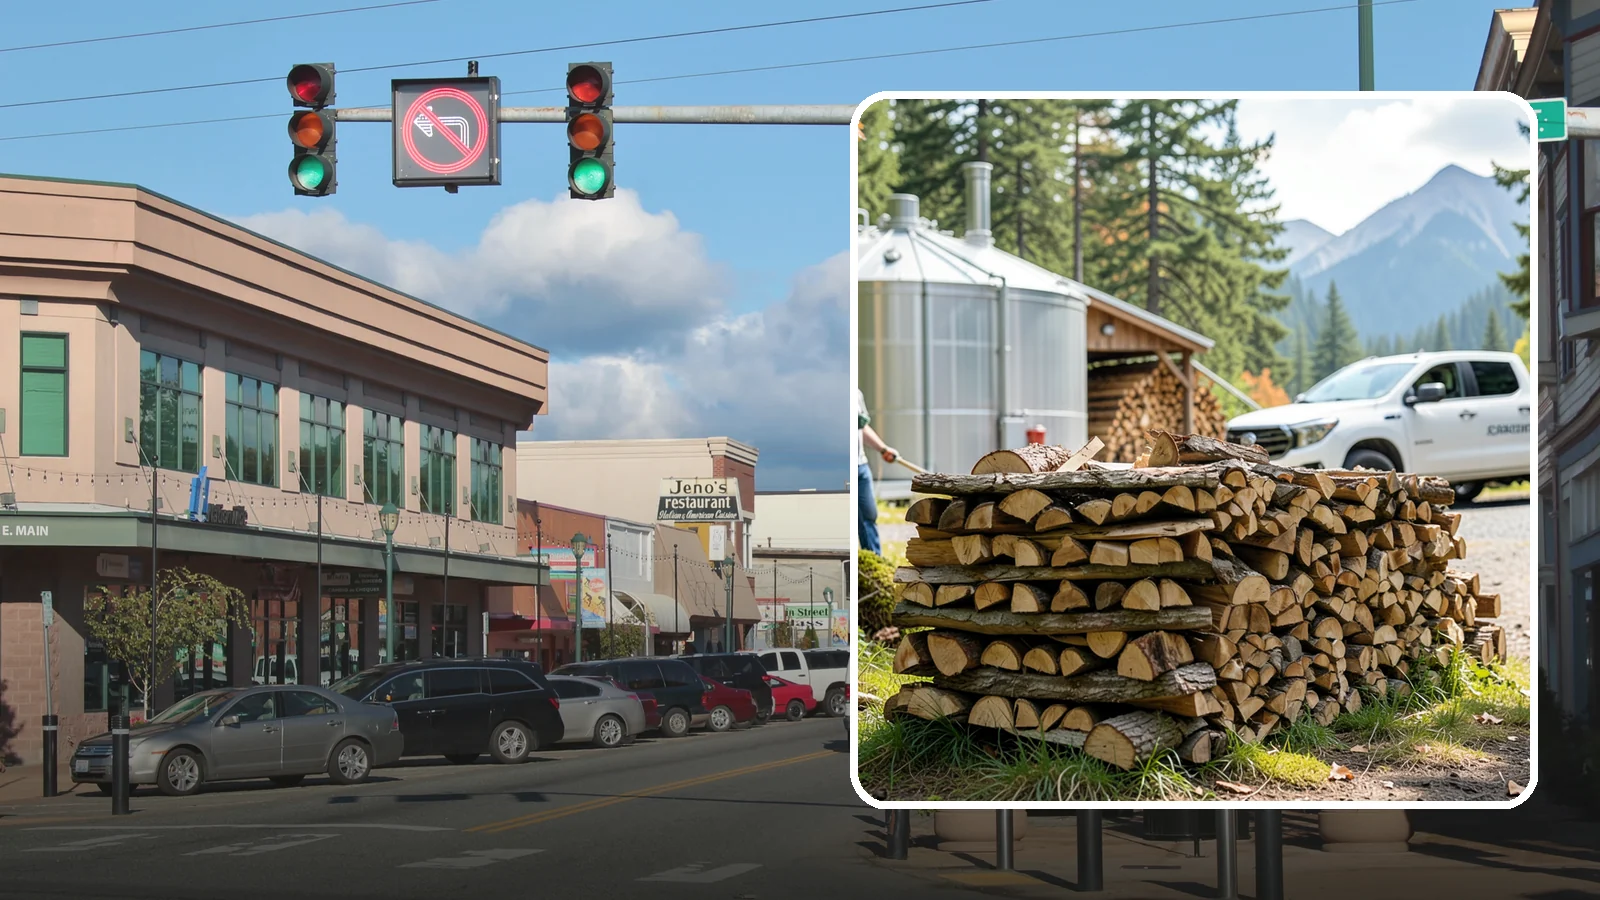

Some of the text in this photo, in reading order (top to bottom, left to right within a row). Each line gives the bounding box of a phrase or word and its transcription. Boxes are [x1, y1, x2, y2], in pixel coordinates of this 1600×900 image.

[669, 480, 727, 494] Jeno's
[665, 496, 731, 509] restaurant
[659, 510, 682, 519] Italian
[686, 509, 714, 519] American
[715, 510, 737, 519] Cuisine
[2, 525, 49, 536] E. MAIN
[797, 607, 828, 616] Street
[791, 619, 824, 627] lass
